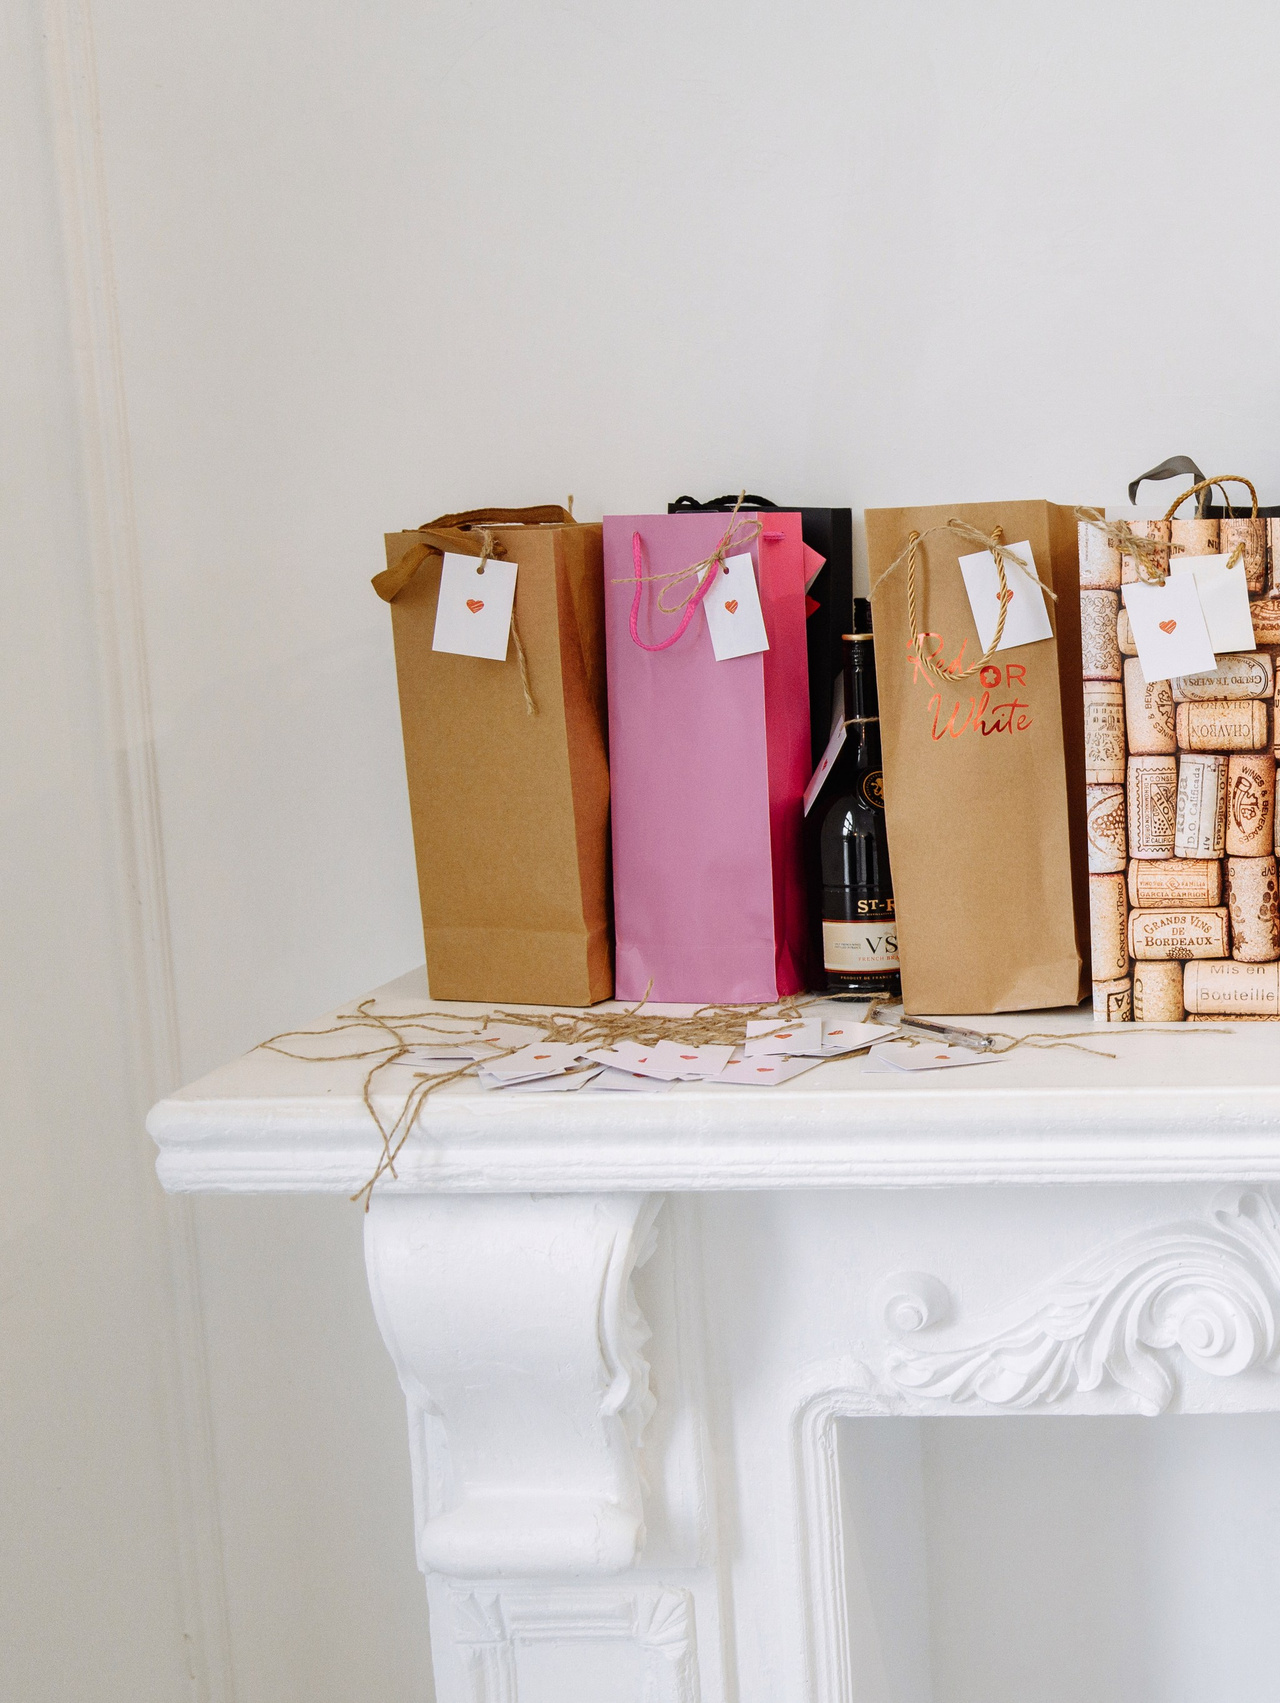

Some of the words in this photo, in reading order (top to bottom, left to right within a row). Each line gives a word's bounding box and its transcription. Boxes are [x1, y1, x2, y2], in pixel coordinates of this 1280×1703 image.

[979, 664, 1027, 688] OR
[927, 691, 1033, 740] White
[1241, 765, 1265, 788] WINES
[1189, 767, 1201, 816] Calificada
[1143, 916, 1187, 935] GRANDS
[1190, 915, 1213, 934] VINS
[1171, 927, 1185, 936] DE
[1145, 936, 1213, 947] BORDEAUX
[1210, 964, 1240, 975] Mis
[1246, 966, 1266, 975] en
[1200, 987, 1275, 1002] Bouteille
